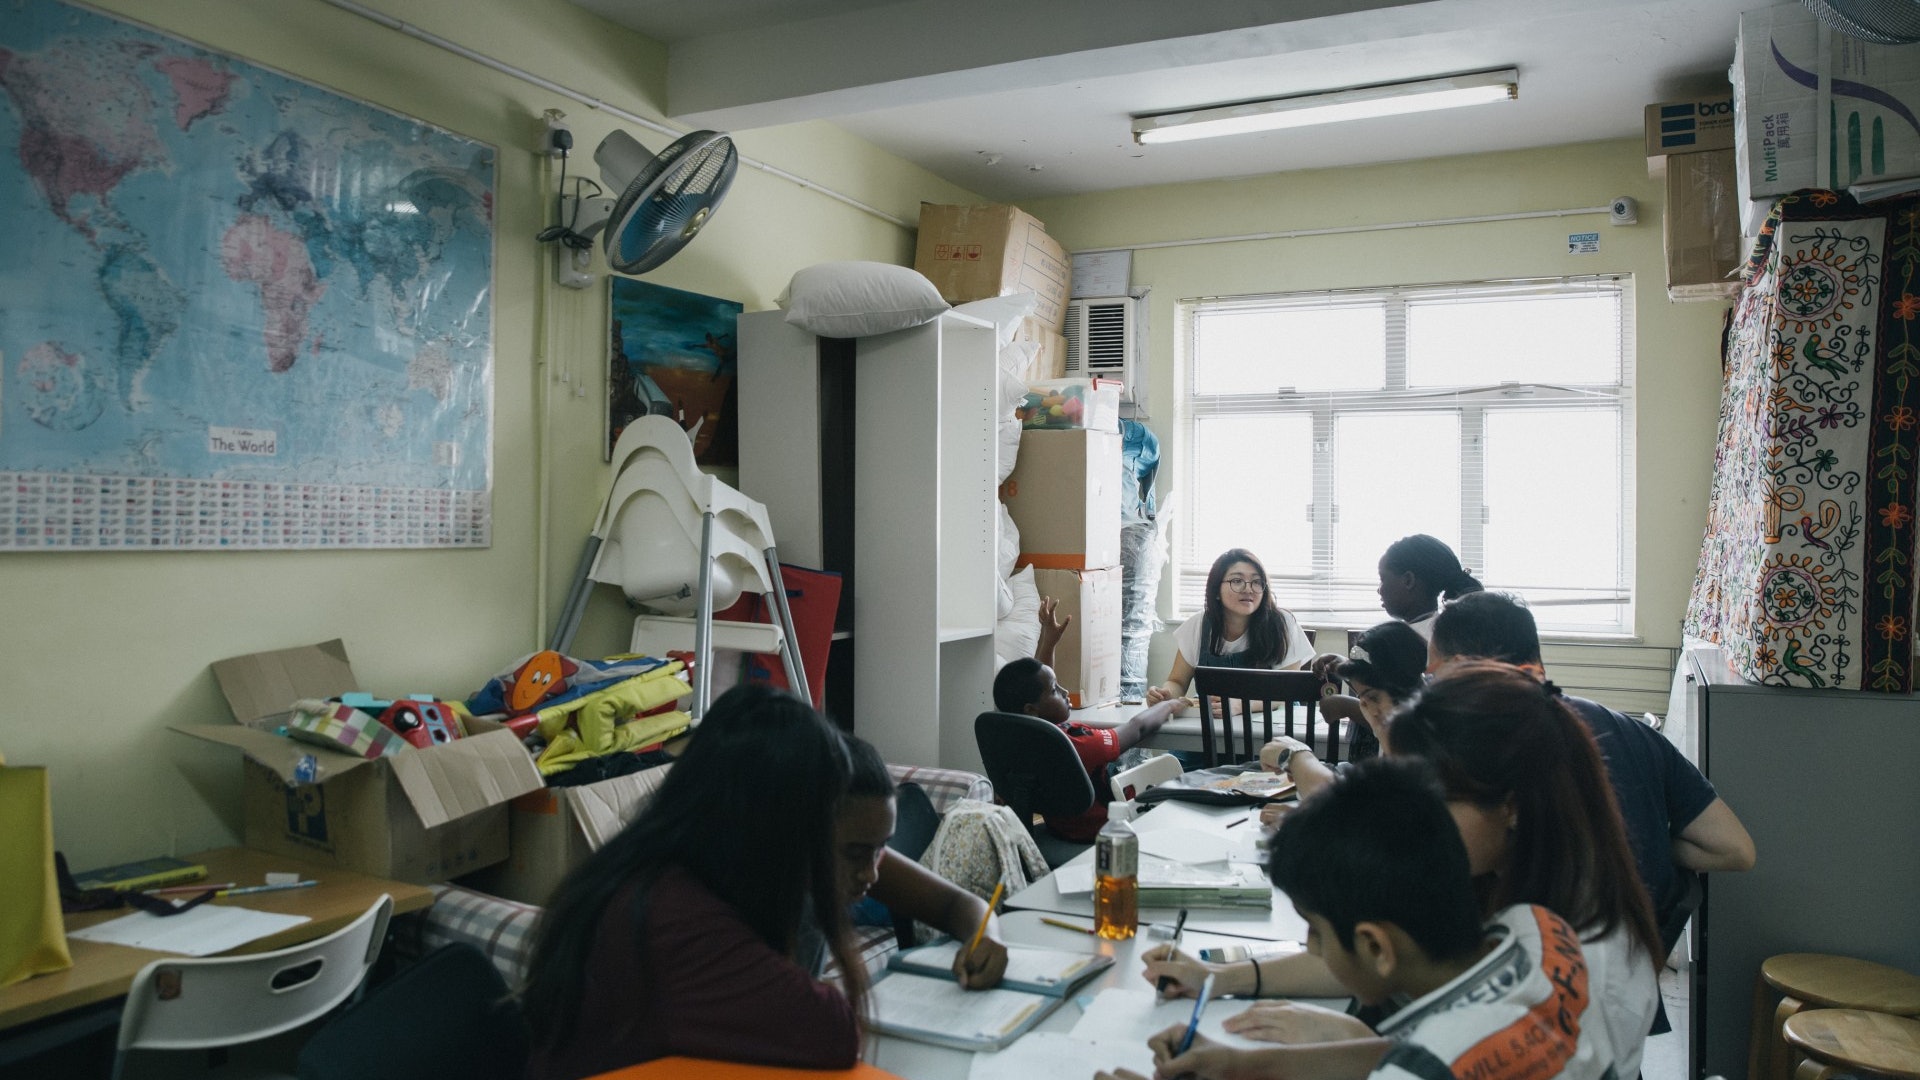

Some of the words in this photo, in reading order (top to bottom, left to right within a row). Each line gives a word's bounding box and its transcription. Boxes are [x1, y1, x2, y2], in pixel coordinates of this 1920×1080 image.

[1762, 114, 1778, 182] MultiPack
[1570, 233, 1598, 242] NOTICE
[211, 437, 235, 452] The
[238, 439, 275, 454] World
